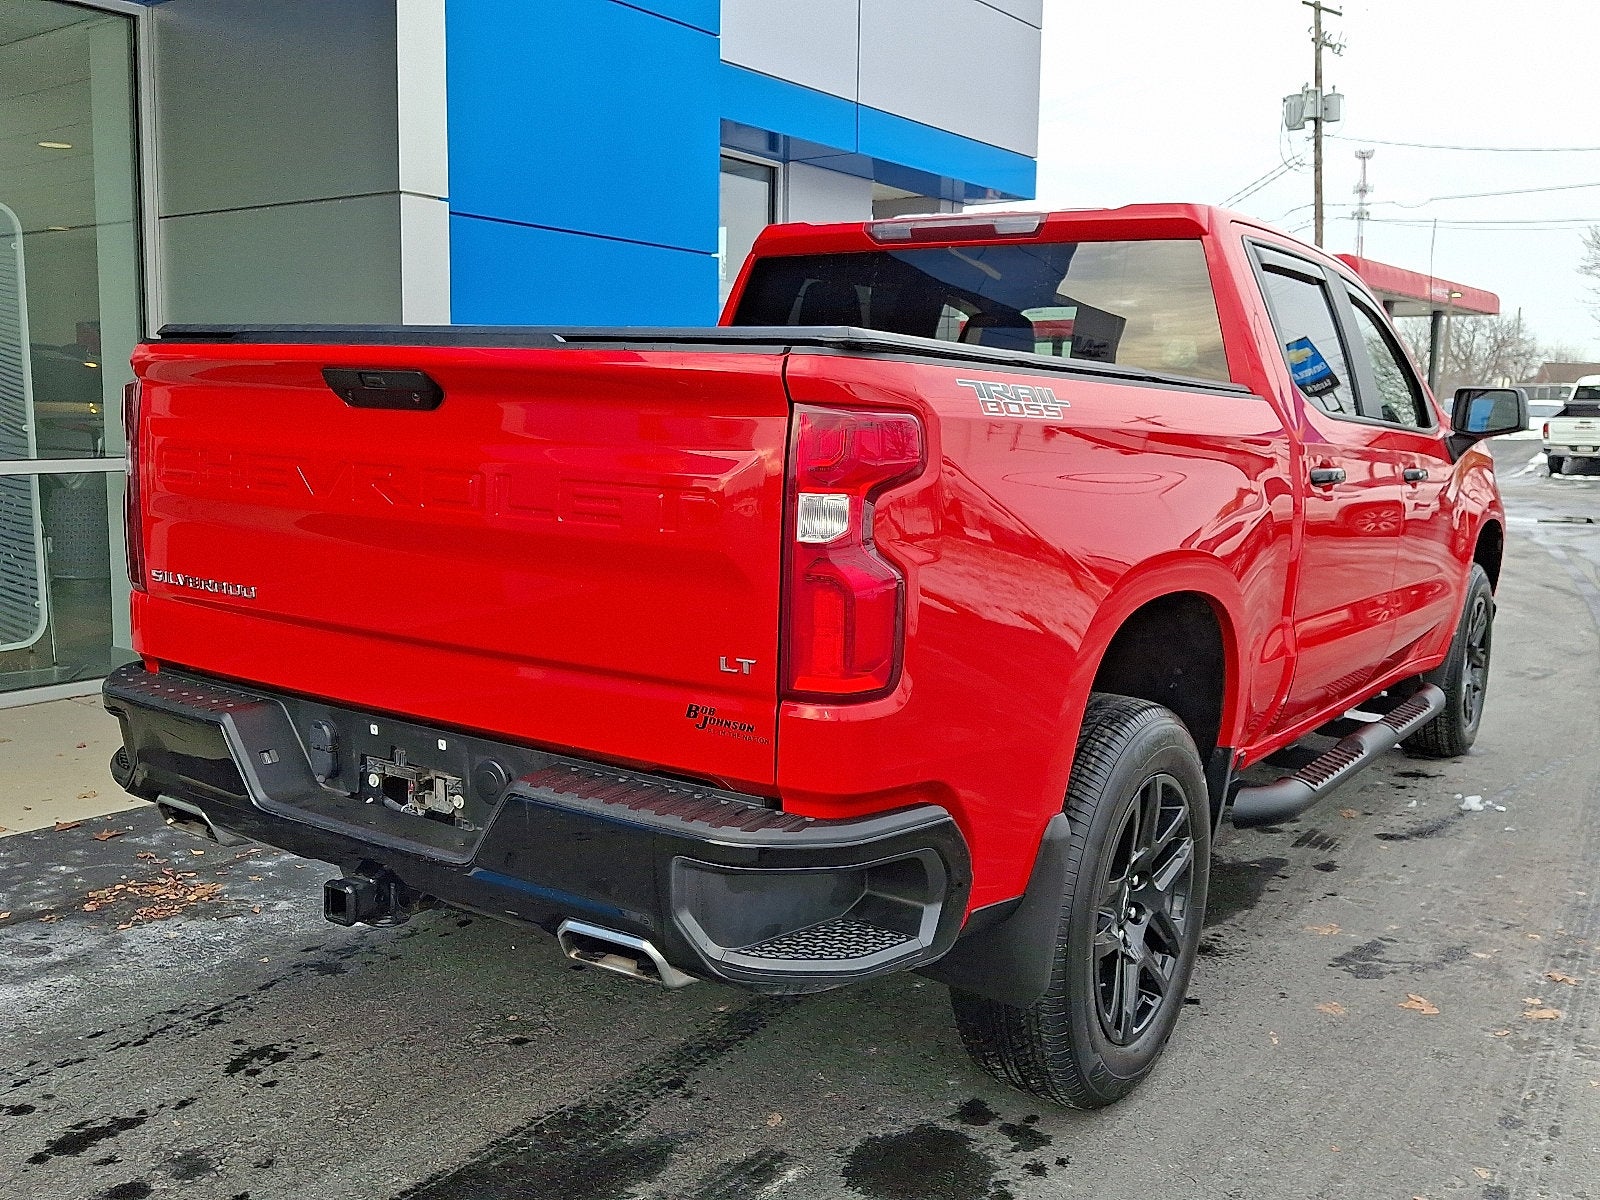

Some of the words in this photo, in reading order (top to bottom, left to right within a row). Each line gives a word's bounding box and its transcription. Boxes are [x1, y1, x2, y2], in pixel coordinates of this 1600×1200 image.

[955, 378, 1071, 407] TRAIL
[979, 399, 1063, 420] BOSS
[719, 655, 757, 675] LT
